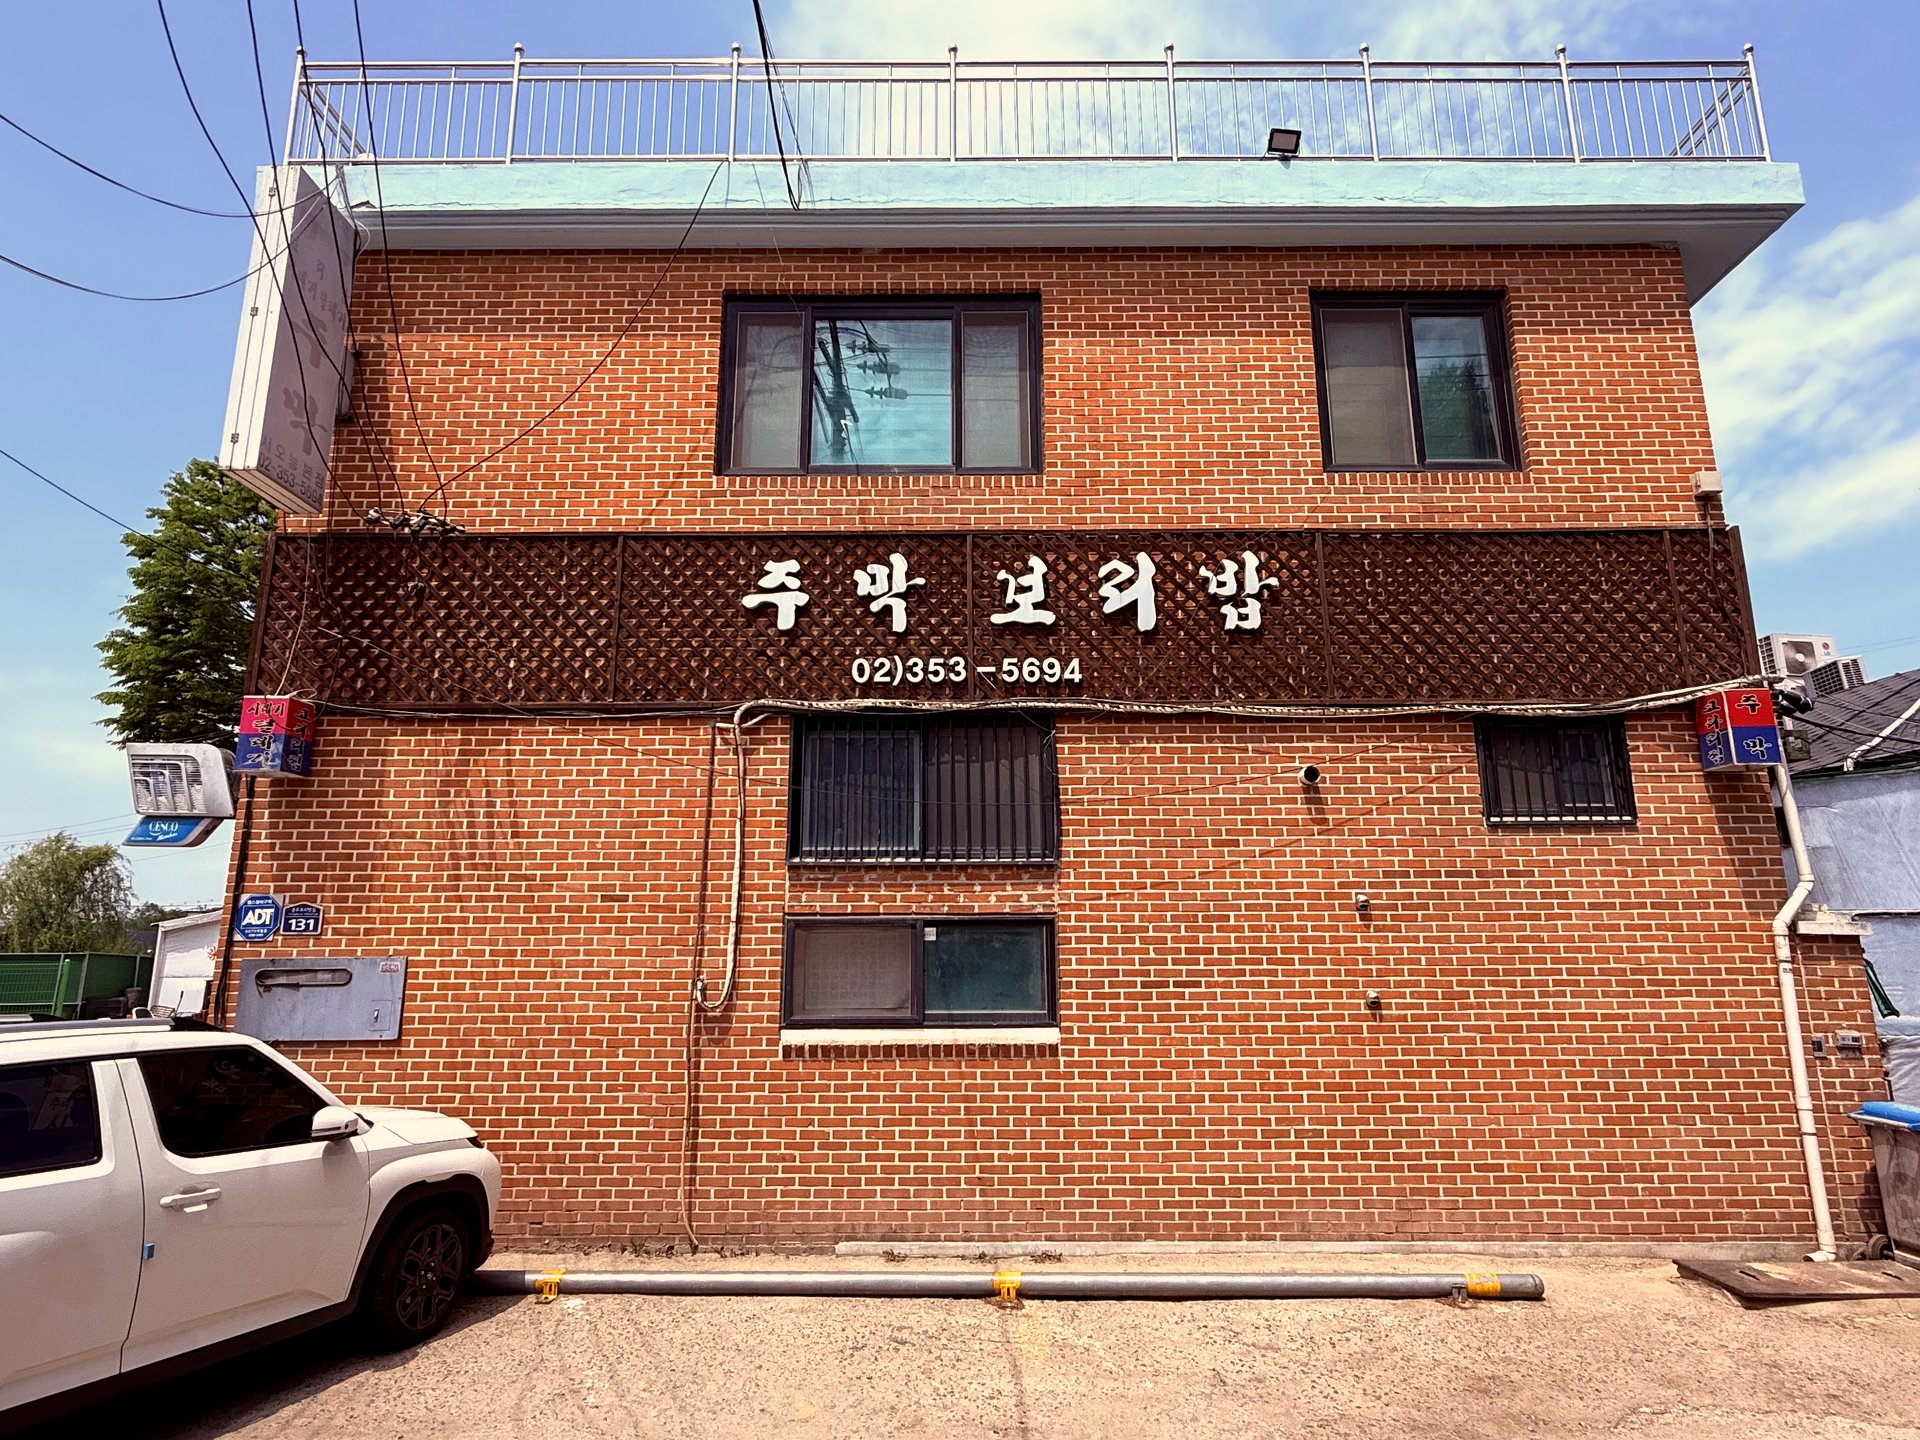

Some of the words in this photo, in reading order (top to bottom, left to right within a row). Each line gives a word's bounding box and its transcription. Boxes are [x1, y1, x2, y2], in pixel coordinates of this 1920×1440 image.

[851, 656, 1083, 686] 02)353-5694
[1735, 694, 1772, 759] 주막
[241, 908, 275, 926] ADT
[288, 918, 316, 931] 131
